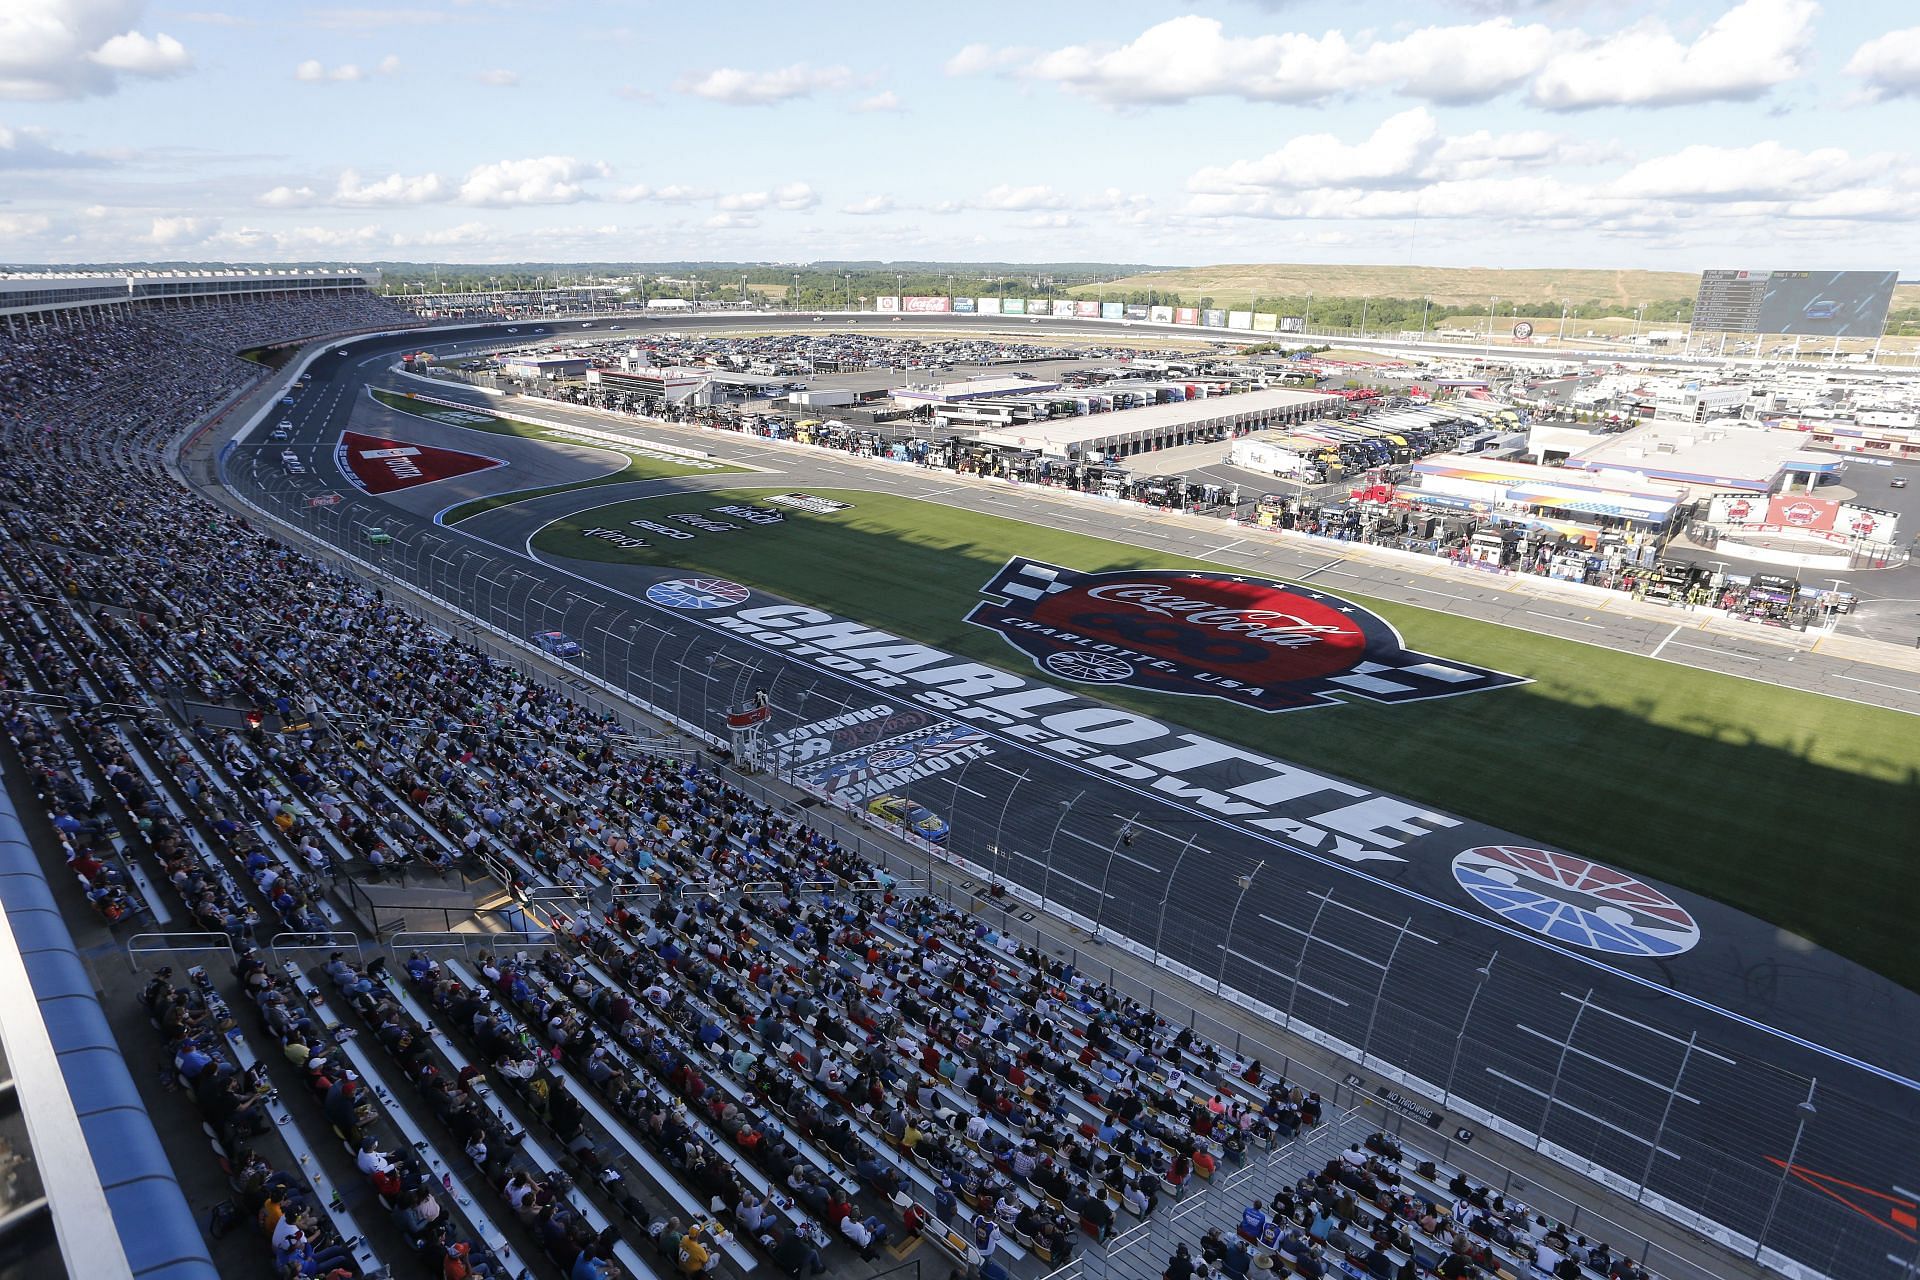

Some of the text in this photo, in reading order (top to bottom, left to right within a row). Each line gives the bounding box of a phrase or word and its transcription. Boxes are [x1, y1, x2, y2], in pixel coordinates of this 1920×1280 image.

[384, 457, 423, 479] TOYOTA
[583, 527, 652, 548] xfinity
[629, 519, 695, 540] GEICO
[1087, 583, 1360, 650] Coca-Cola
[1001, 617, 1266, 697] CHARLOTTE, USA
[706, 616, 1410, 863] MOTOR SPEEDWAY
[737, 605, 1464, 850] CHARLOTTE
[835, 742, 997, 804] CHARLOTTE
[1387, 1091, 1433, 1119] NO THROWING
